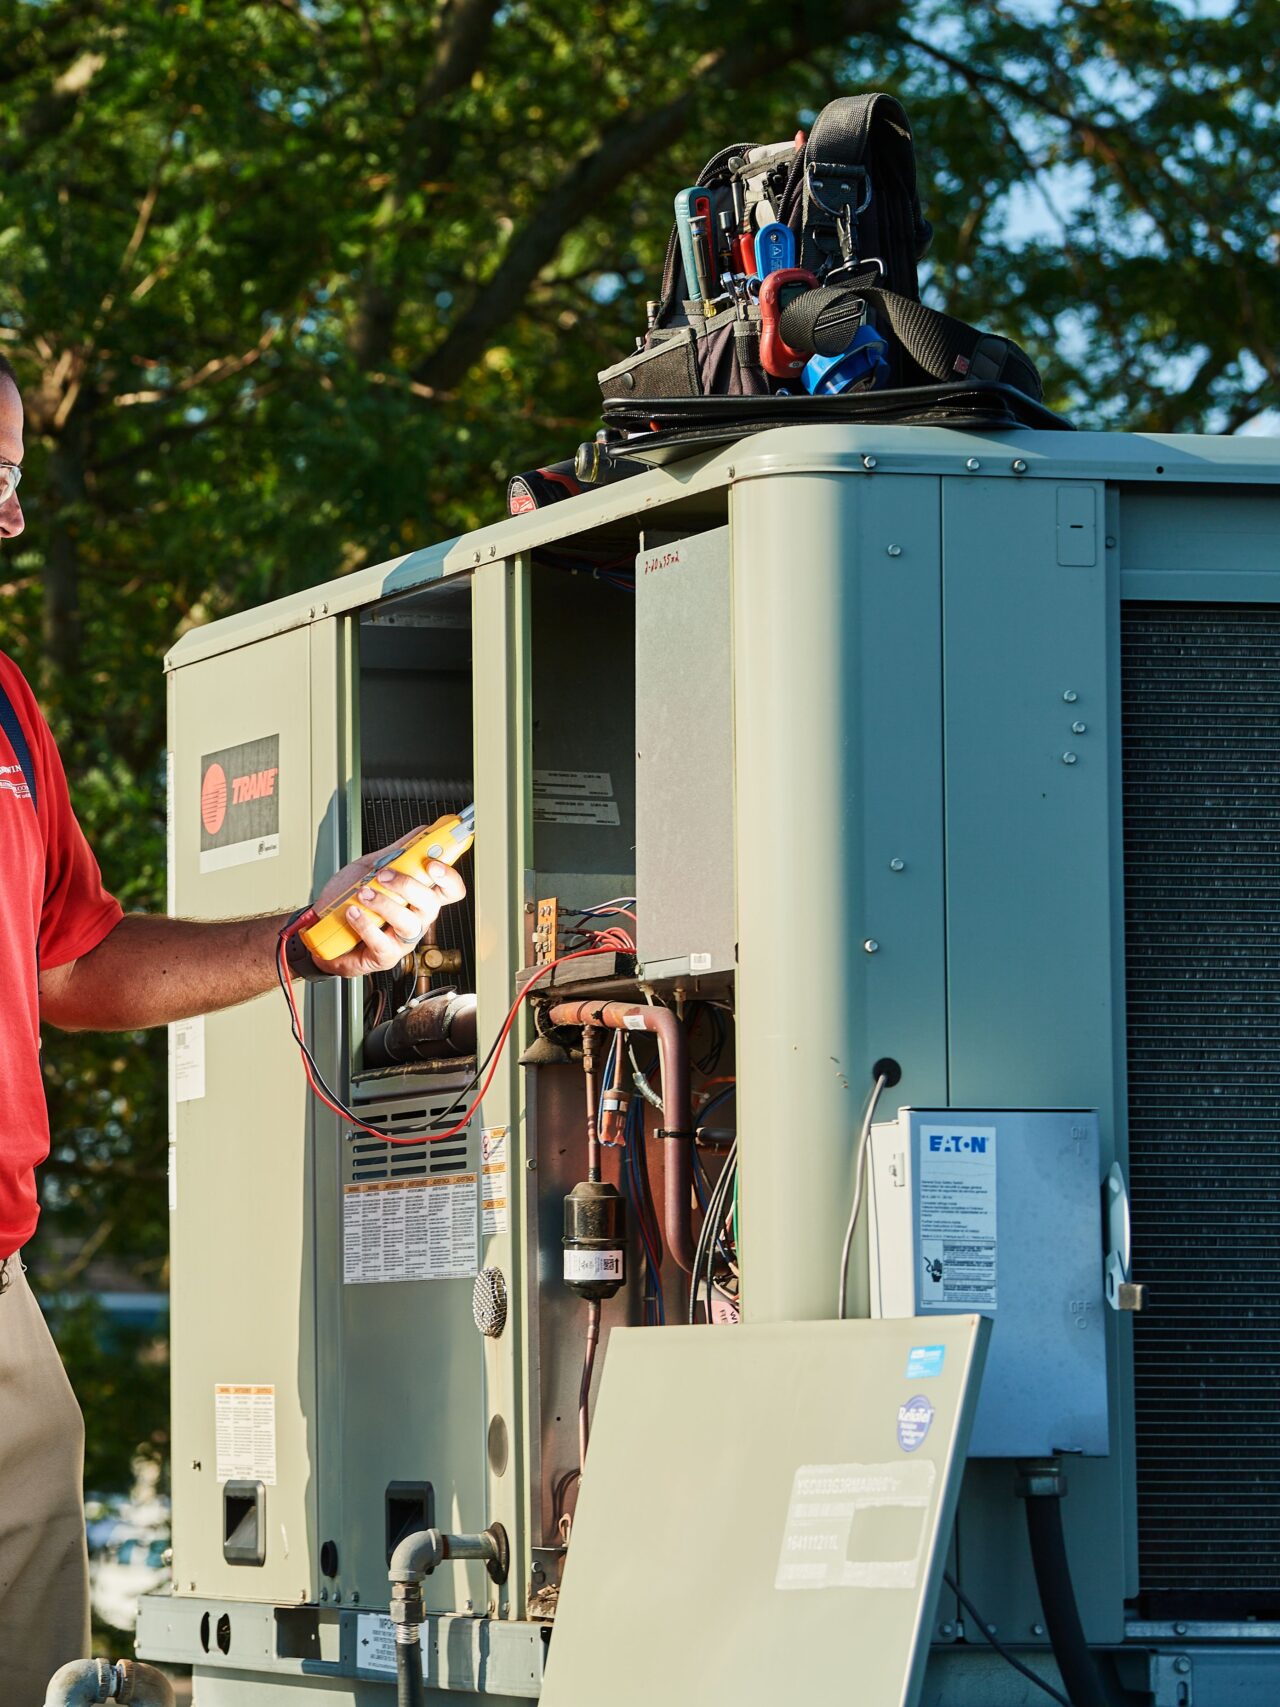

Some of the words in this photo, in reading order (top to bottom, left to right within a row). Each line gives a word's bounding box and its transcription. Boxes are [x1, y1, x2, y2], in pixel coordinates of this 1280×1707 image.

[232, 768, 276, 805] TRANE
[1070, 1126, 1088, 1140] ON
[929, 1135, 986, 1153] EATON
[1069, 1300, 1093, 1314] OFF
